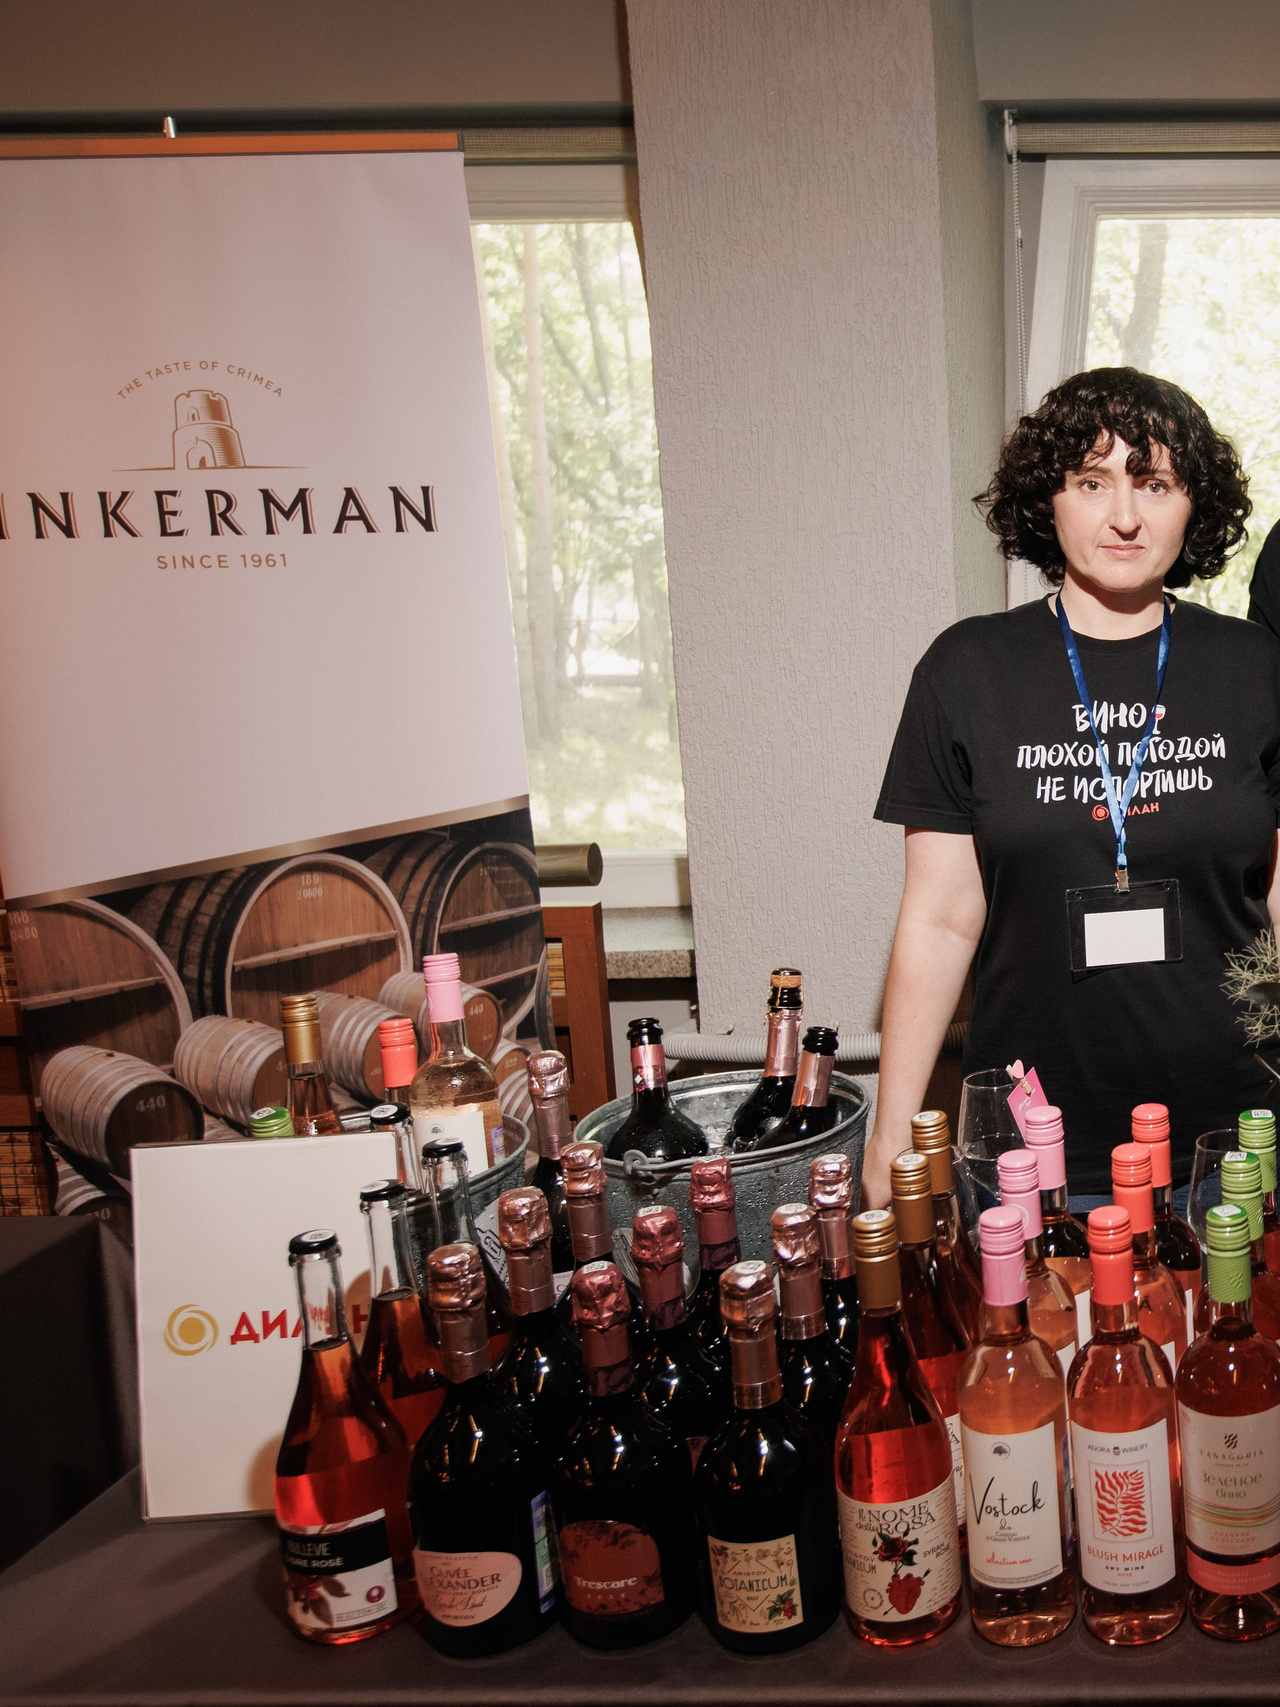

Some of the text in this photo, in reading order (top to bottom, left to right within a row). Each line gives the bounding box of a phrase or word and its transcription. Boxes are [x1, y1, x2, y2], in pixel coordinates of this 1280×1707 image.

[117, 360, 283, 400] THE TASTE OF CRIMEA
[156, 553, 287, 569] SINCE 1961
[1072, 700, 1147, 733] ВИНО
[1016, 733, 1226, 769] ПЛОХОЙ ПОГОДОЙ
[1036, 776, 1066, 803] НЕ
[136, 1096, 166, 1112] 440
[1088, 1443, 1149, 1453] AGORA WINERY
[970, 1473, 1046, 1525] Vostock
[868, 1500, 930, 1522] NOME
[856, 1512, 936, 1534] della ROSA
[923, 1542, 945, 1558] SYRAH
[1087, 1544, 1164, 1562] BLUSH MIRAGE
[311, 1556, 344, 1567] ROSÉ
[575, 1576, 638, 1589] Trescare
